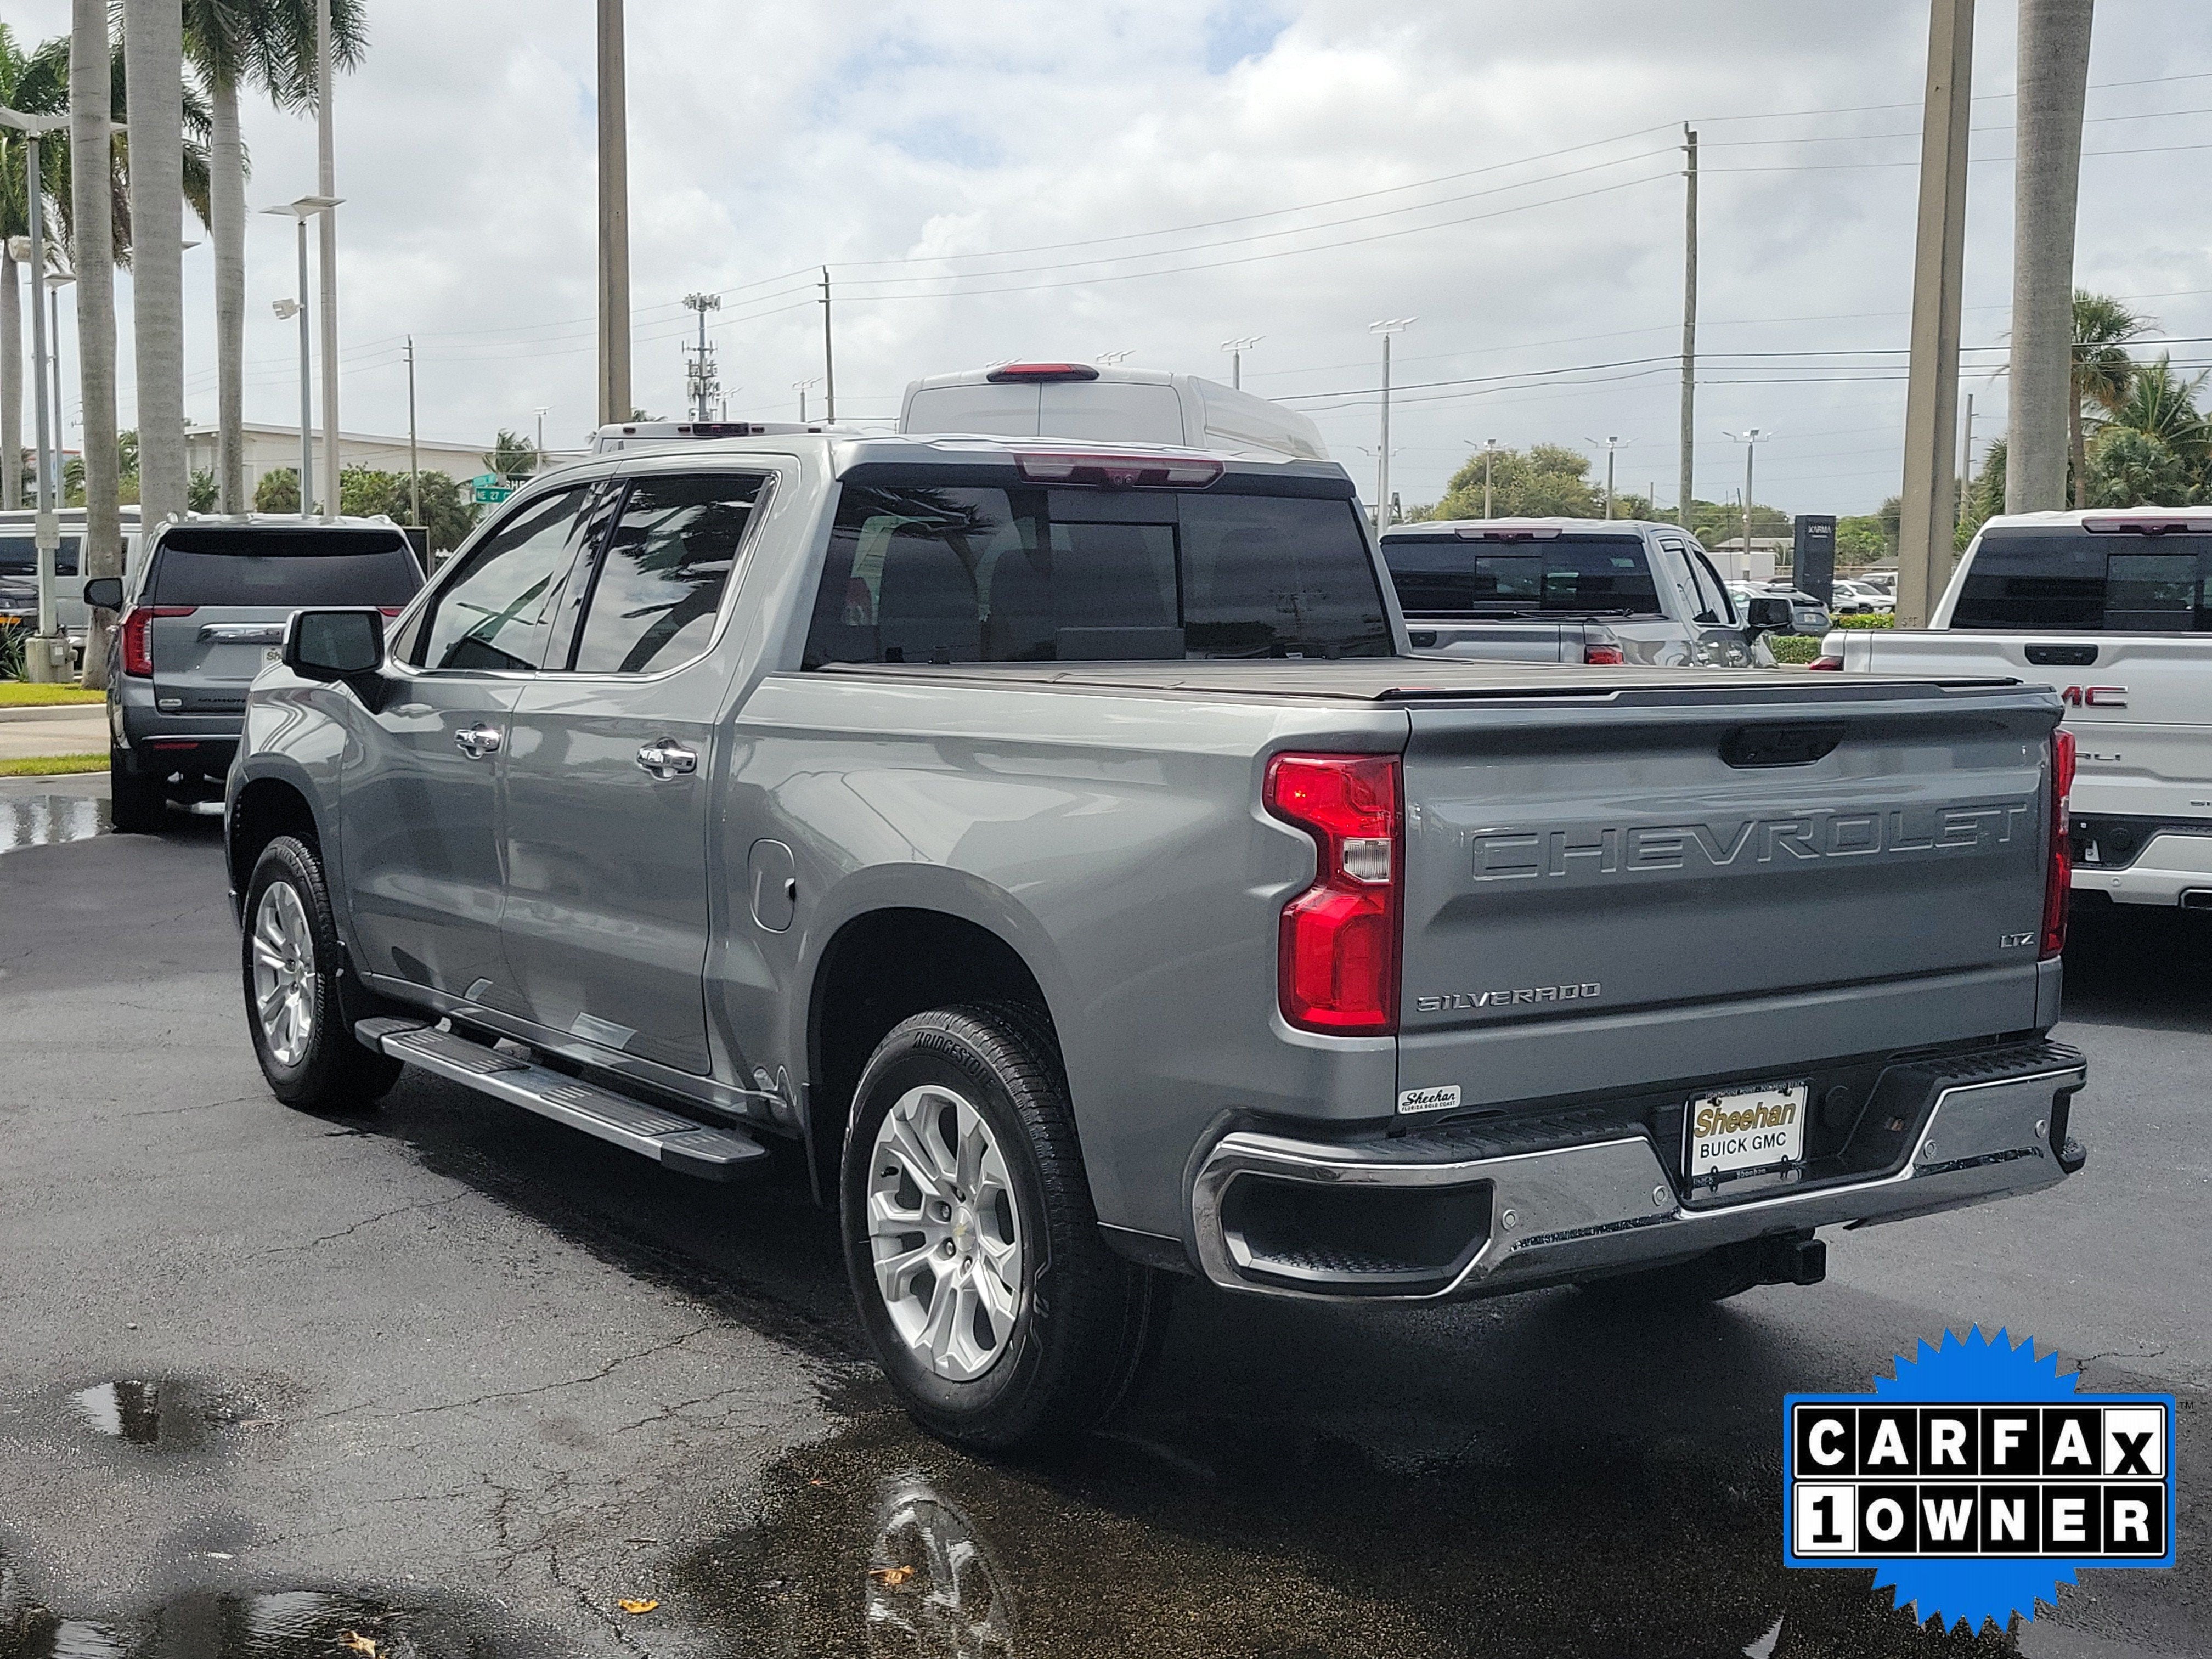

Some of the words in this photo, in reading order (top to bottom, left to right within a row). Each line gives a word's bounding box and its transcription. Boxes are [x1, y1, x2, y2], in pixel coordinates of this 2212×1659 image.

[477, 491, 487, 500] NE
[490, 491, 499, 500] 27
[1472, 802, 2027, 881] CHEVROLET
[2000, 932, 2035, 949] LTZ
[1417, 983, 1601, 1012] SILVERADO
[1402, 1089, 1456, 1106] Sheehan
[1694, 1102, 1796, 1138] Sheehan
[1701, 1137, 1747, 1159] BUICK
[1752, 1132, 1786, 1150] GMC
